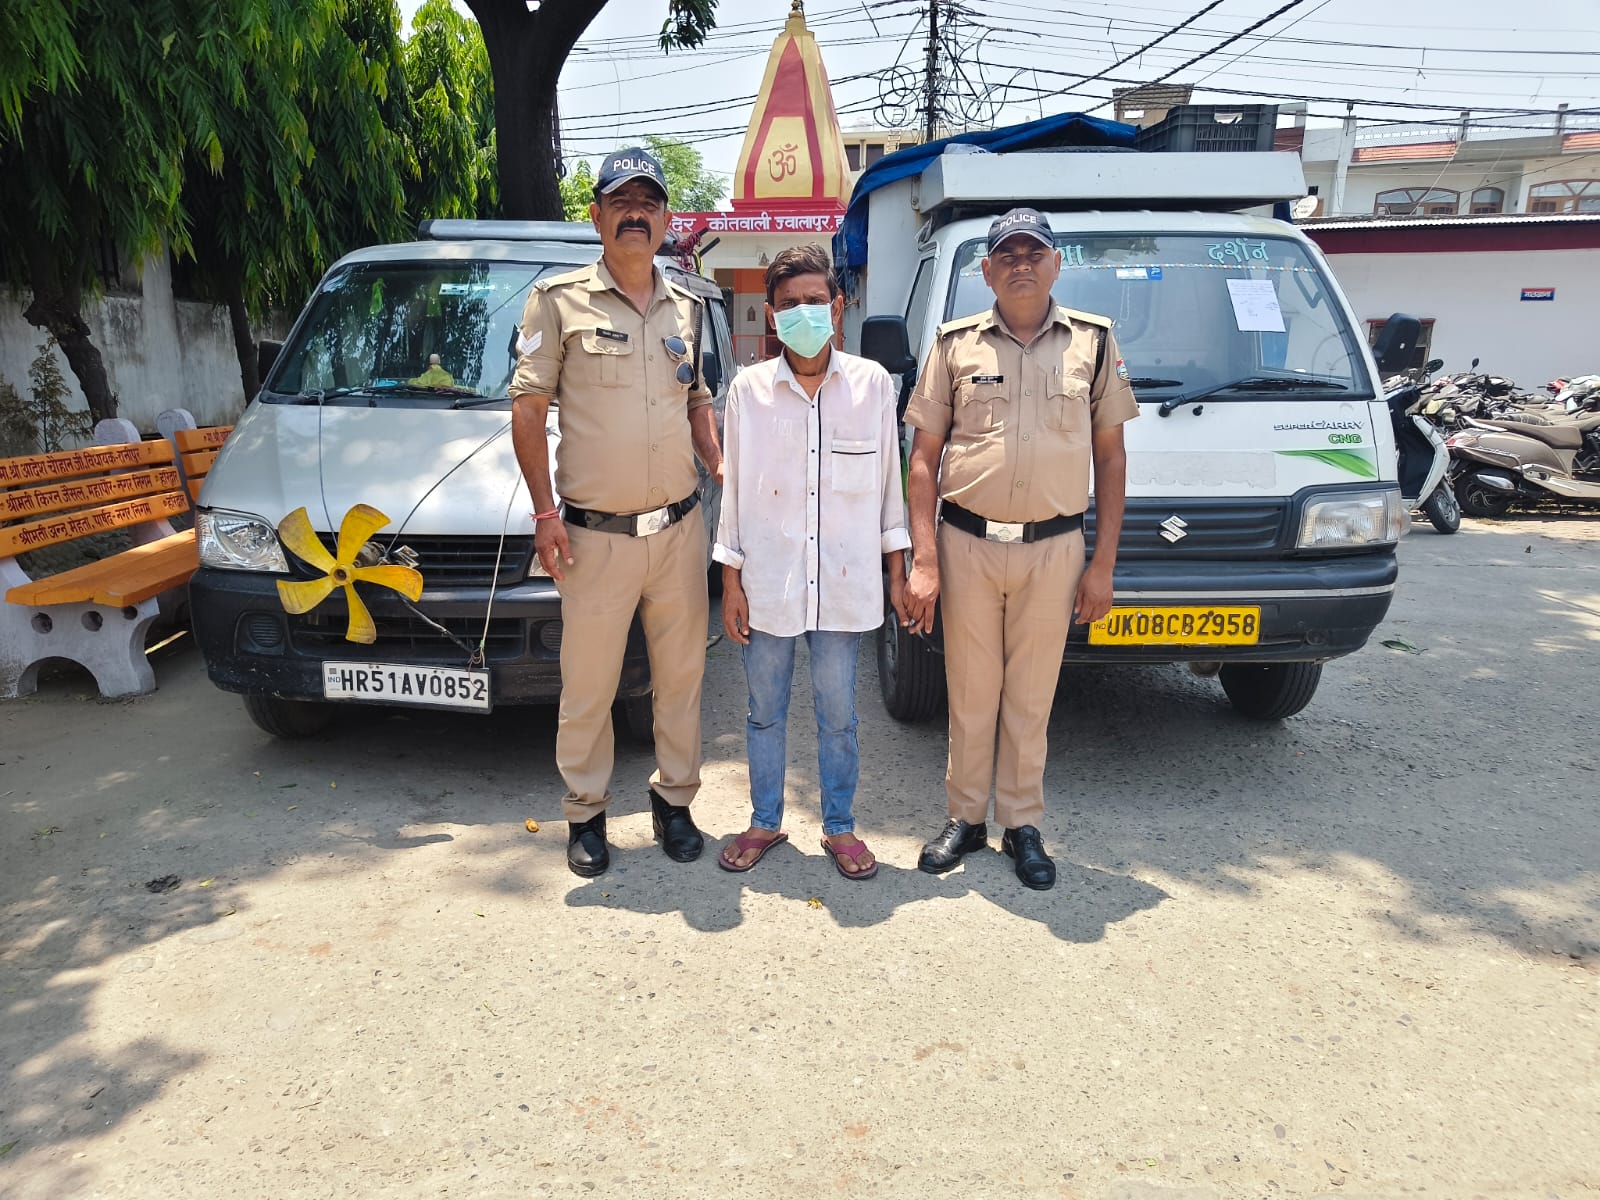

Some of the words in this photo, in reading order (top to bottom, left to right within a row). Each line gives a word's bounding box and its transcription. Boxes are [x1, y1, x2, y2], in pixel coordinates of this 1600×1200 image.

[614, 158, 656, 176] POLICE
[706, 212, 772, 231] कोतवाली
[1000, 213, 1038, 232] POLICE
[1204, 237, 1270, 264] दर्शन
[1327, 433, 1363, 445] CNG
[21, 458, 48, 478] आदेश
[6, 491, 36, 513] श्रीमती
[132, 474, 153, 489] निगम
[158, 469, 178, 488] हरिद्वार
[19, 524, 49, 545] श्रीमती
[131, 502, 152, 519] निगम
[1106, 613, 1257, 638] UK08CB2958
[327, 676, 341, 684] IND
[340, 668, 488, 702] HR51AV0852
